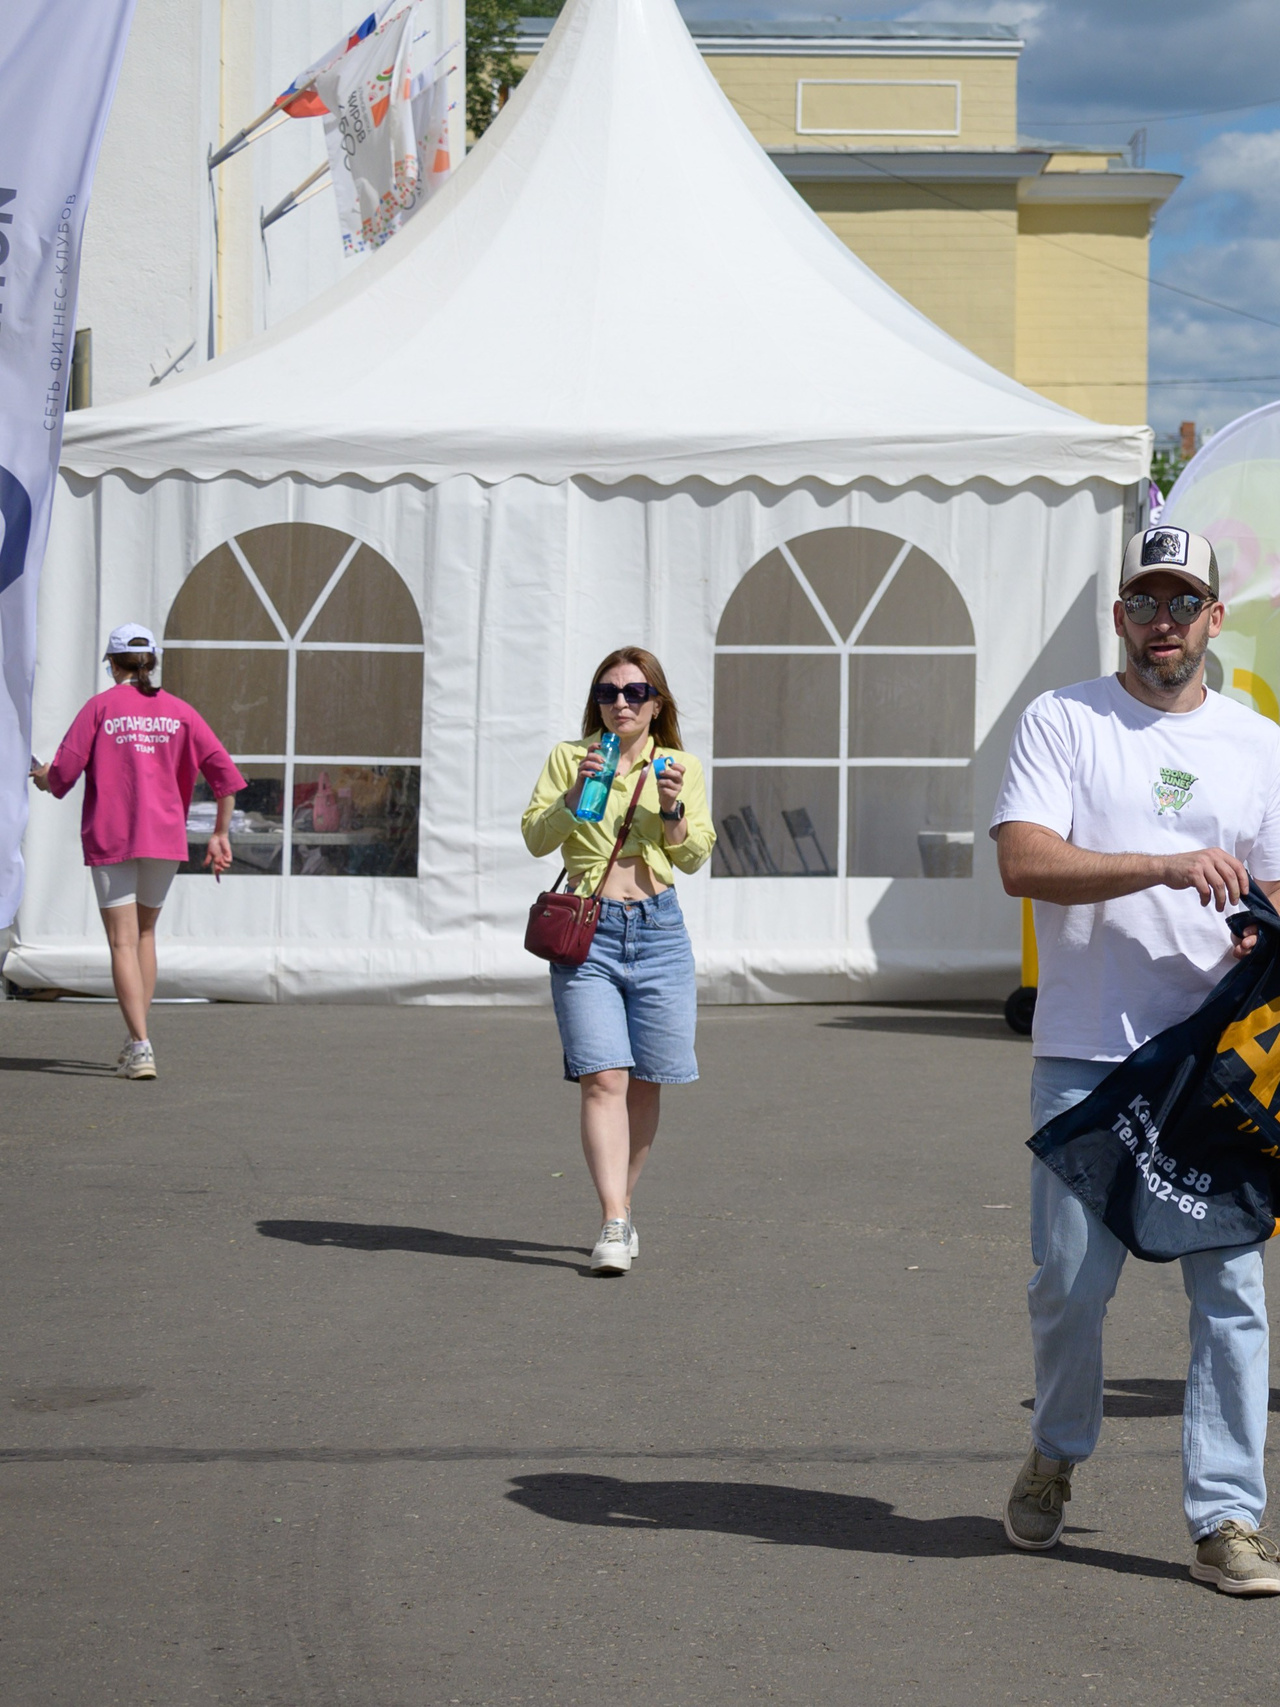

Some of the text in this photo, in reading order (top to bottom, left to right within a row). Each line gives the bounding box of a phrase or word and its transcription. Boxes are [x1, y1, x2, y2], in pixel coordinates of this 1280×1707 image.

[43, 193, 77, 431] СЕТЬ ФИТНЕС-КЛУБОВ
[115, 733, 137, 744] GYM
[1160, 767, 1197, 782] LOONEY
[1162, 775, 1191, 790] TUNES
[1182, 1167, 1212, 1193] 38
